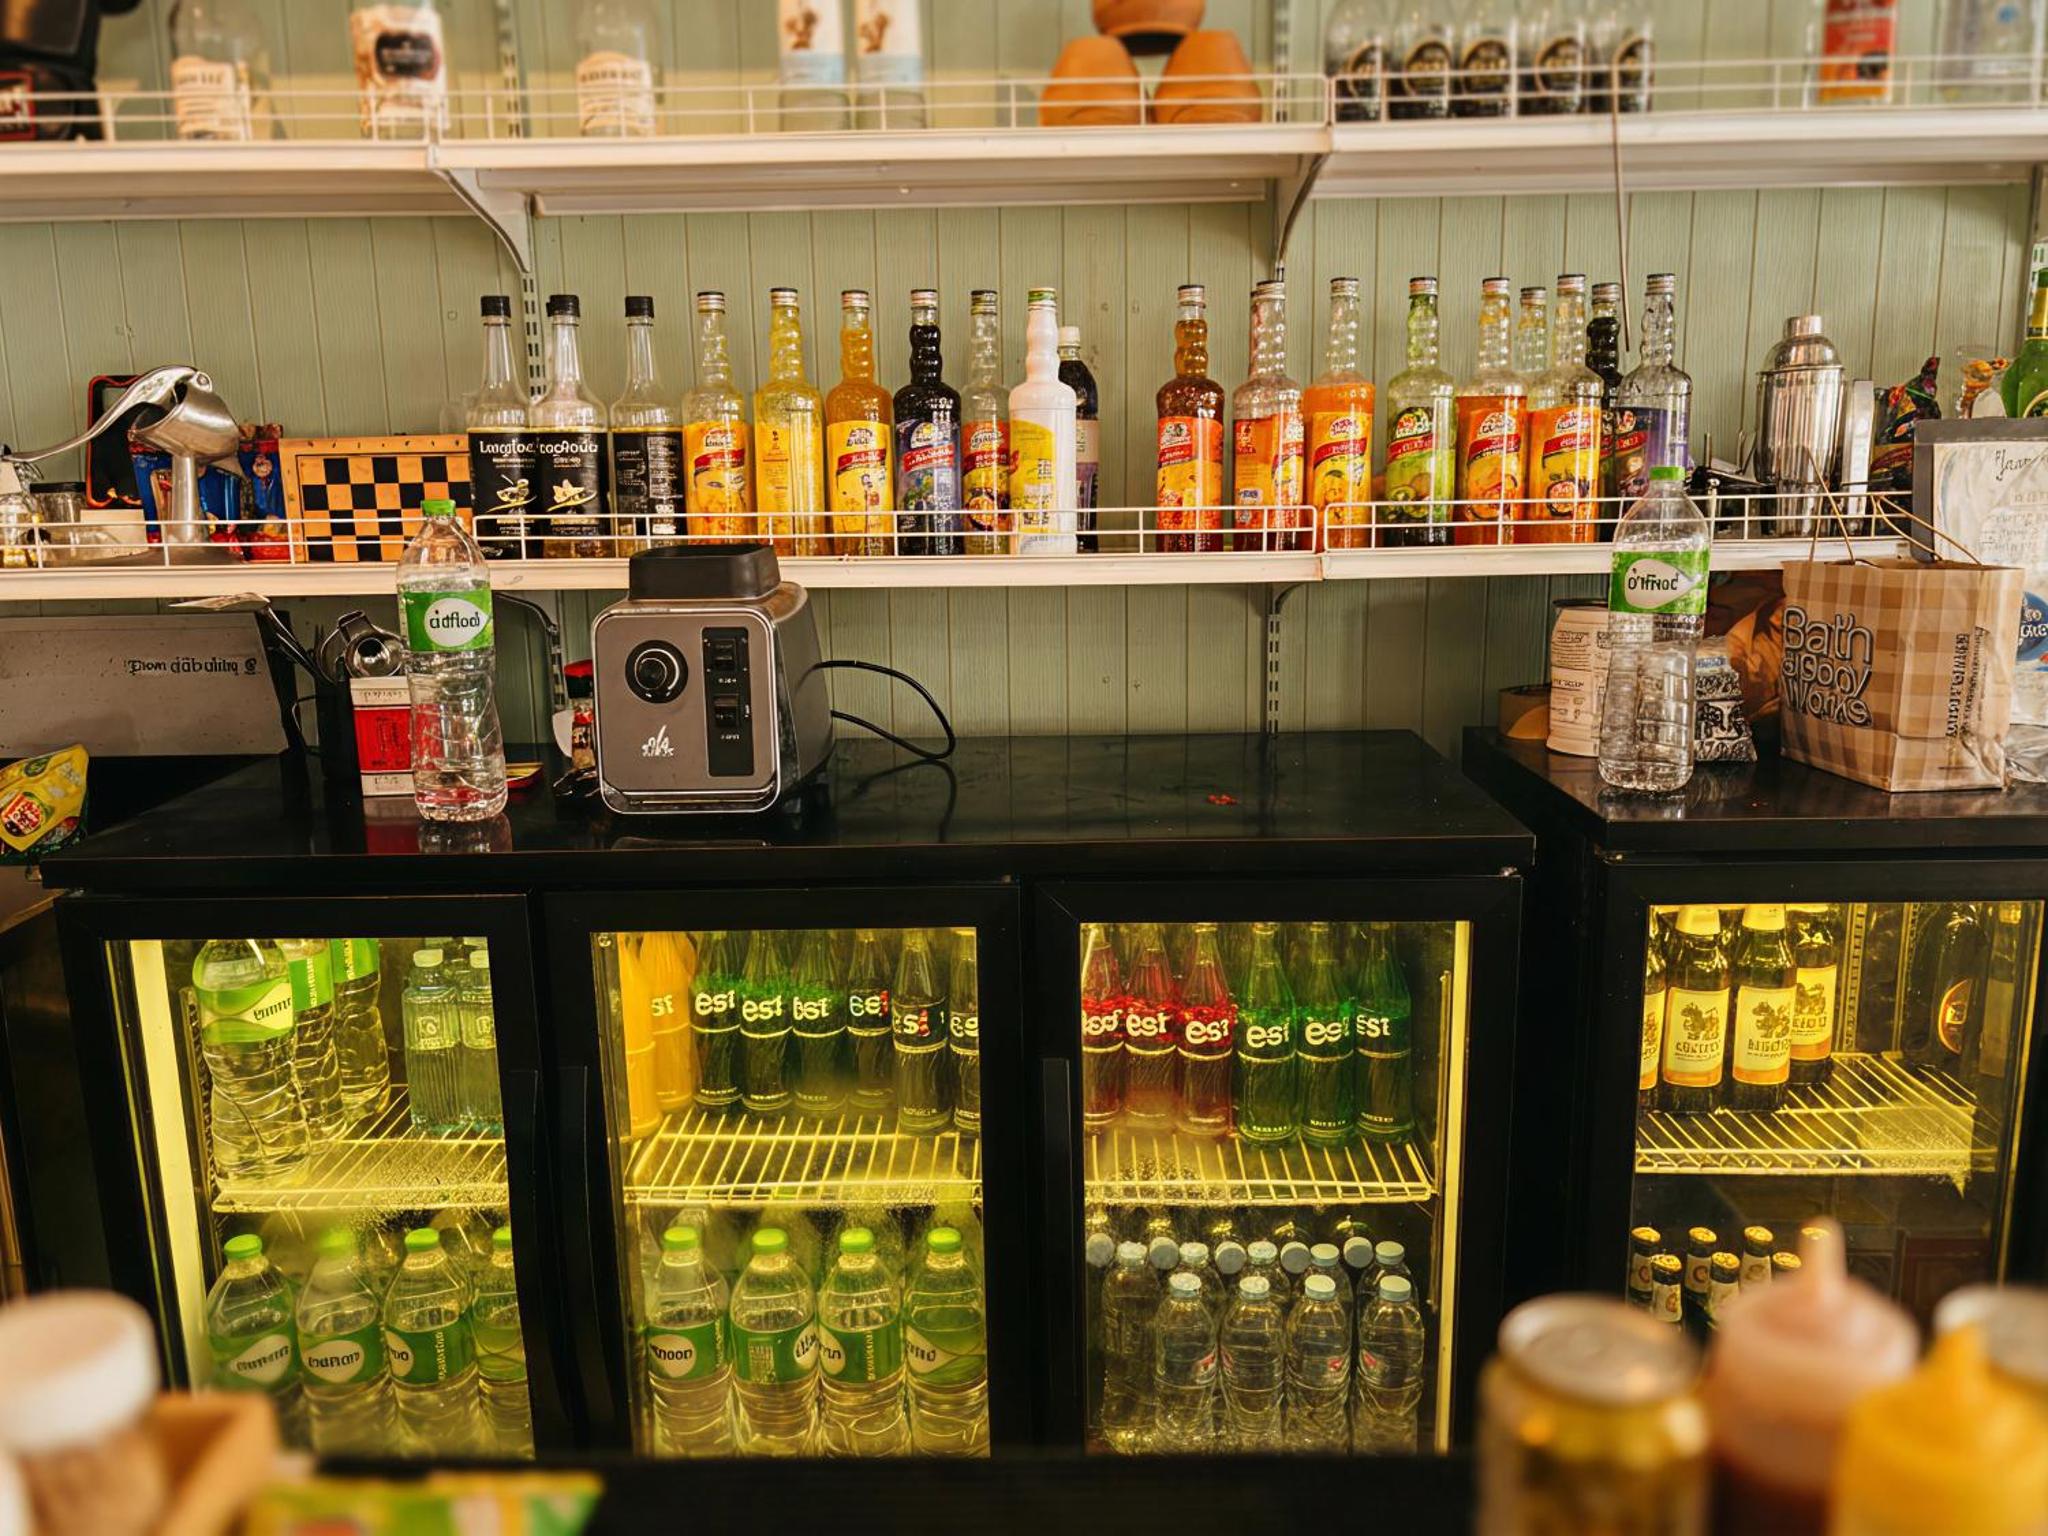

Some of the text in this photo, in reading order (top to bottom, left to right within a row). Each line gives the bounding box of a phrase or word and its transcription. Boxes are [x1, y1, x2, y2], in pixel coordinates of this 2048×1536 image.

[1783, 606, 1873, 664] Bath
[694, 990, 736, 1016] est
[742, 995, 782, 1022] est
[1126, 1012, 1169, 1037] est
[1185, 1018, 1230, 1044] est
[1247, 1017, 1290, 1048] est
